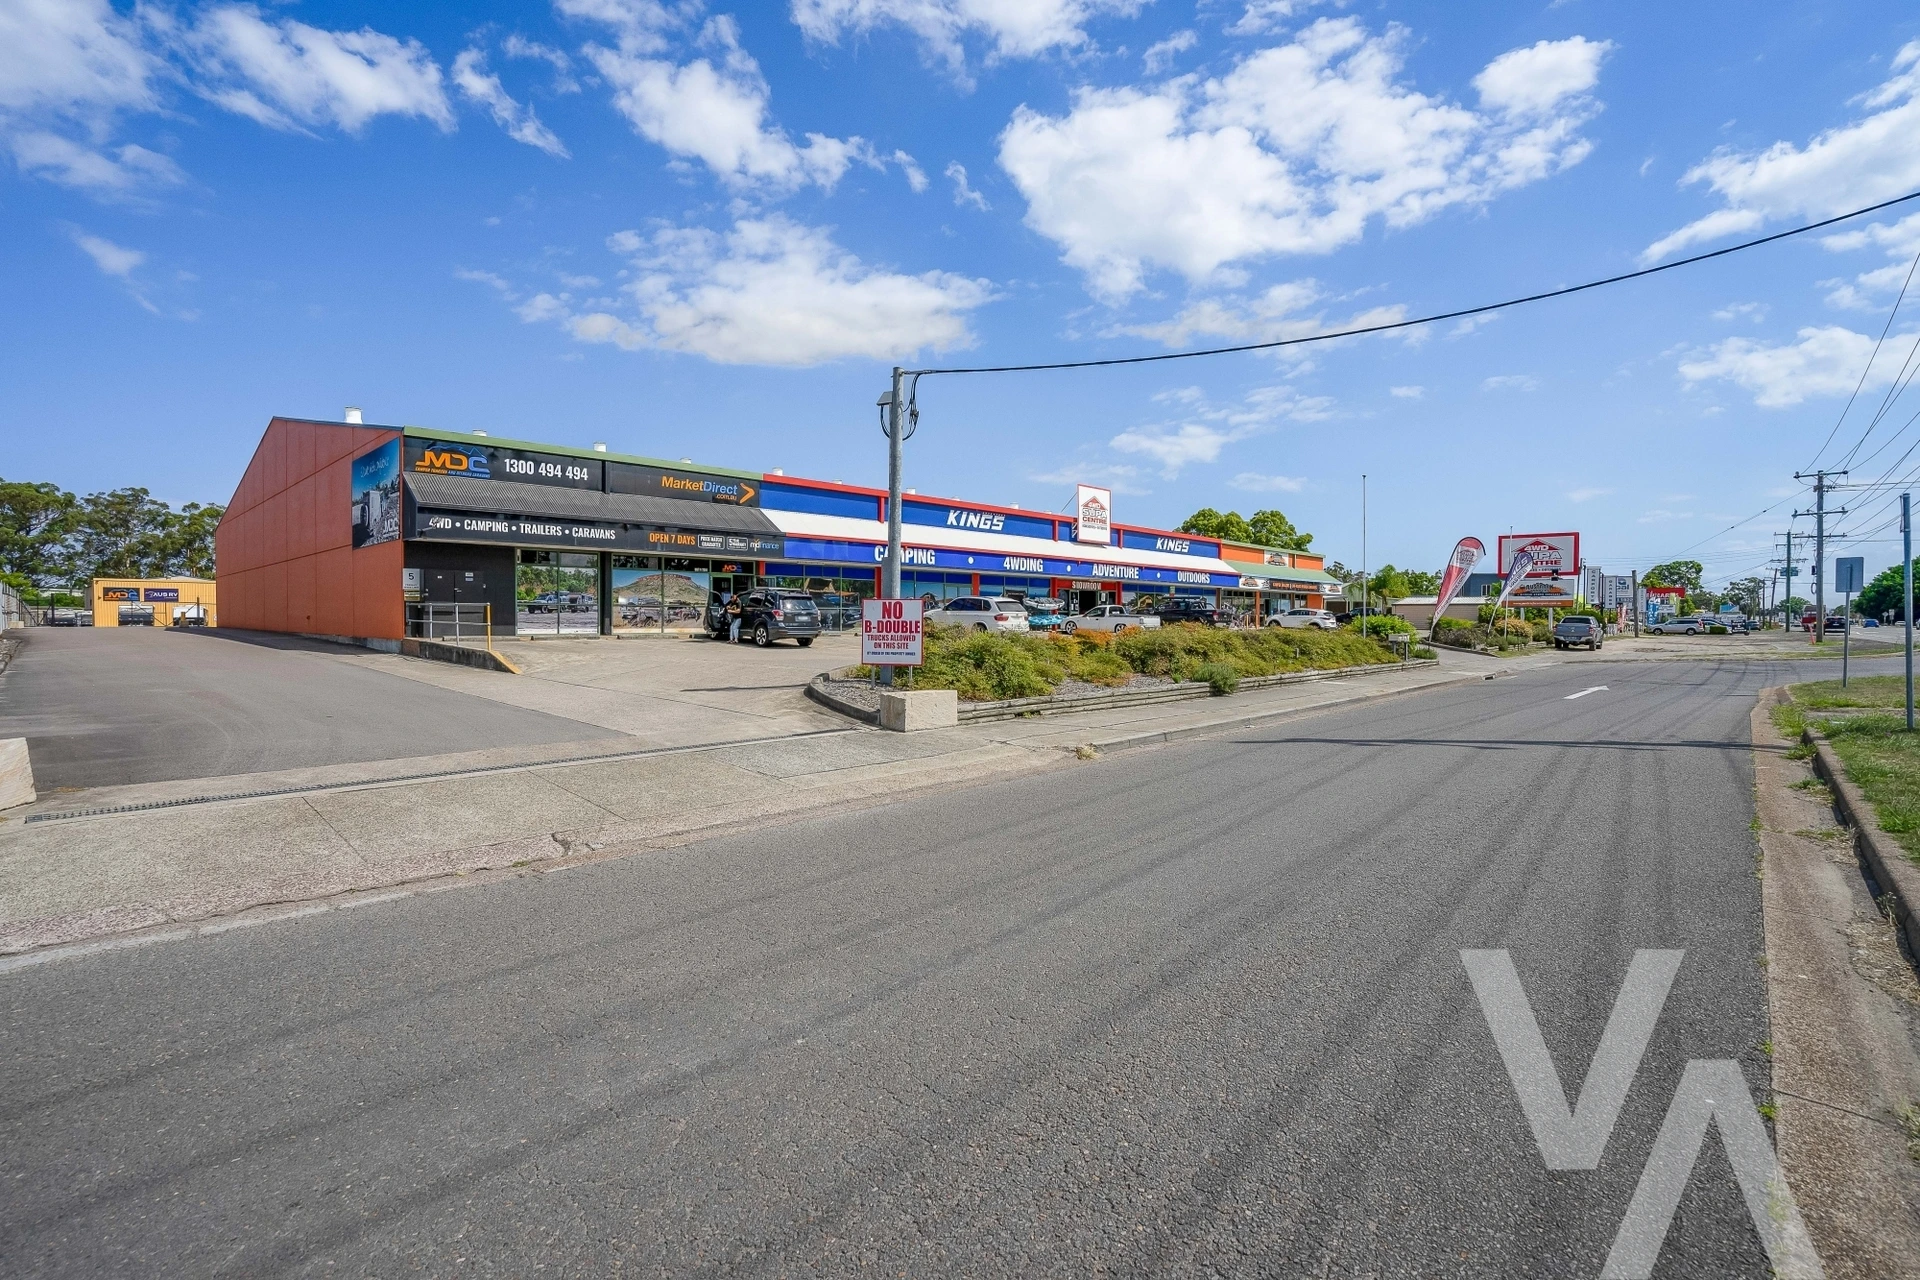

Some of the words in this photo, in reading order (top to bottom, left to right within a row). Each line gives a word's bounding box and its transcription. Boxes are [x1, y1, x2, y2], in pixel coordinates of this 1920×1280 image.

[415, 450, 490, 473] MDC
[504, 458, 535, 475] 1300
[538, 462, 562, 478] 494
[565, 465, 589, 481] 494
[661, 476, 738, 495] MarketDirect
[946, 509, 1006, 531] KINGS
[1082, 508, 1108, 518] SUPA
[1082, 516, 1108, 525] CENTRE
[428, 517, 452, 529] 4WD
[464, 519, 509, 533] CAMPING
[519, 522, 562, 536] TRAILERS
[572, 526, 616, 540] CARAVANS
[649, 532, 669, 543] OPEN
[671, 534, 676, 543] 7
[677, 535, 696, 545] DAYS
[1156, 537, 1190, 553] KINGS
[408, 572, 415, 580] 5
[1003, 556, 1044, 572] 4WDING
[1092, 563, 1139, 579] ADVENTURE
[1177, 570, 1211, 584] OUTDOORS
[881, 601, 903, 619] NO
[865, 620, 920, 633] B-DOUBLE
[890, 634, 916, 642] ALLOWED
[896, 642, 909, 650] SITE
